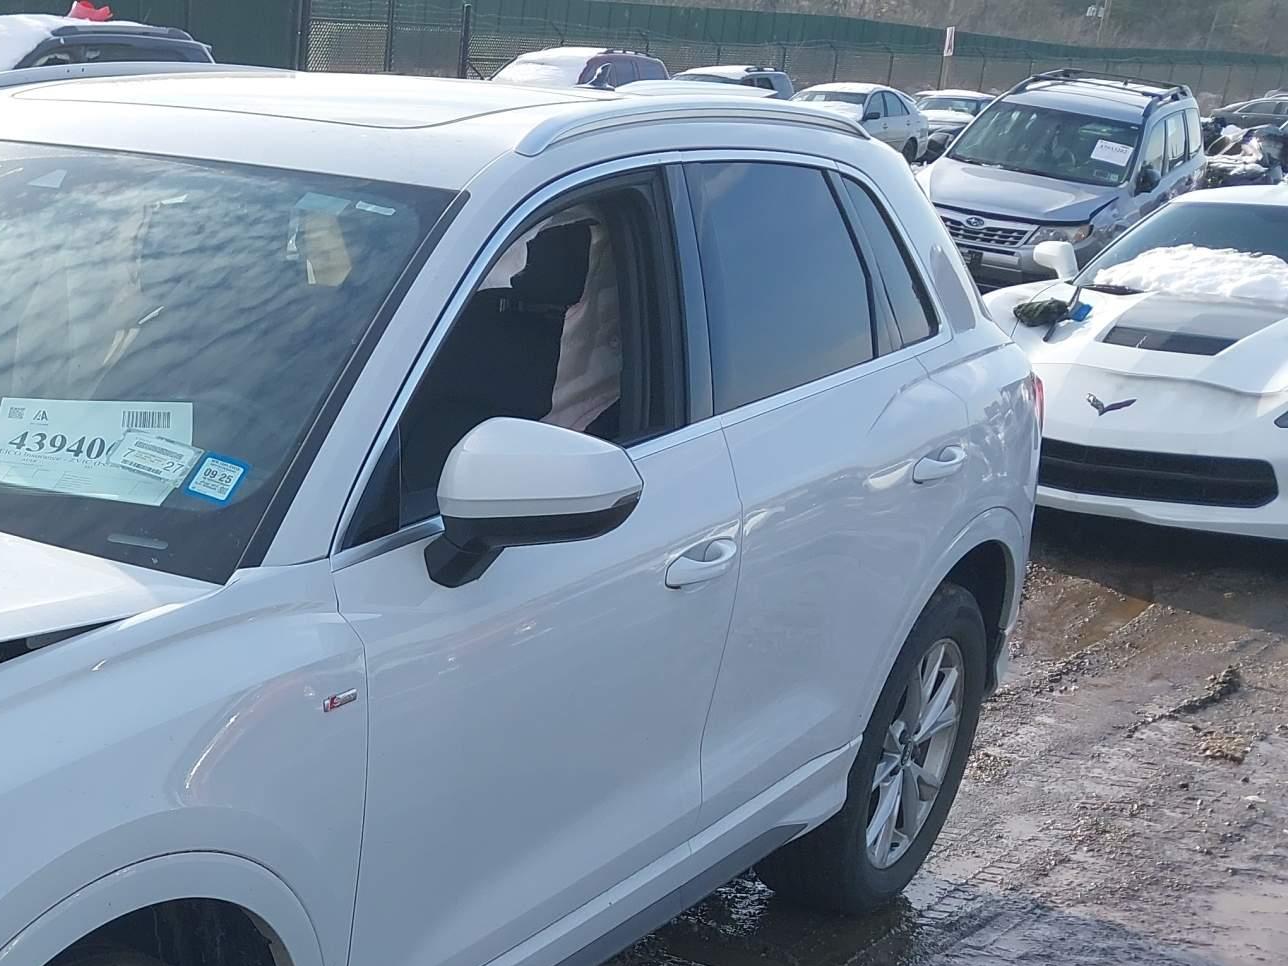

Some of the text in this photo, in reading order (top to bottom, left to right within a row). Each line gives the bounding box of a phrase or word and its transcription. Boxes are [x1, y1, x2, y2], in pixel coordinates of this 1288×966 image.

[164, 460, 185, 473] 27
[203, 467, 218, 479] 09
[218, 472, 234, 484] 25
